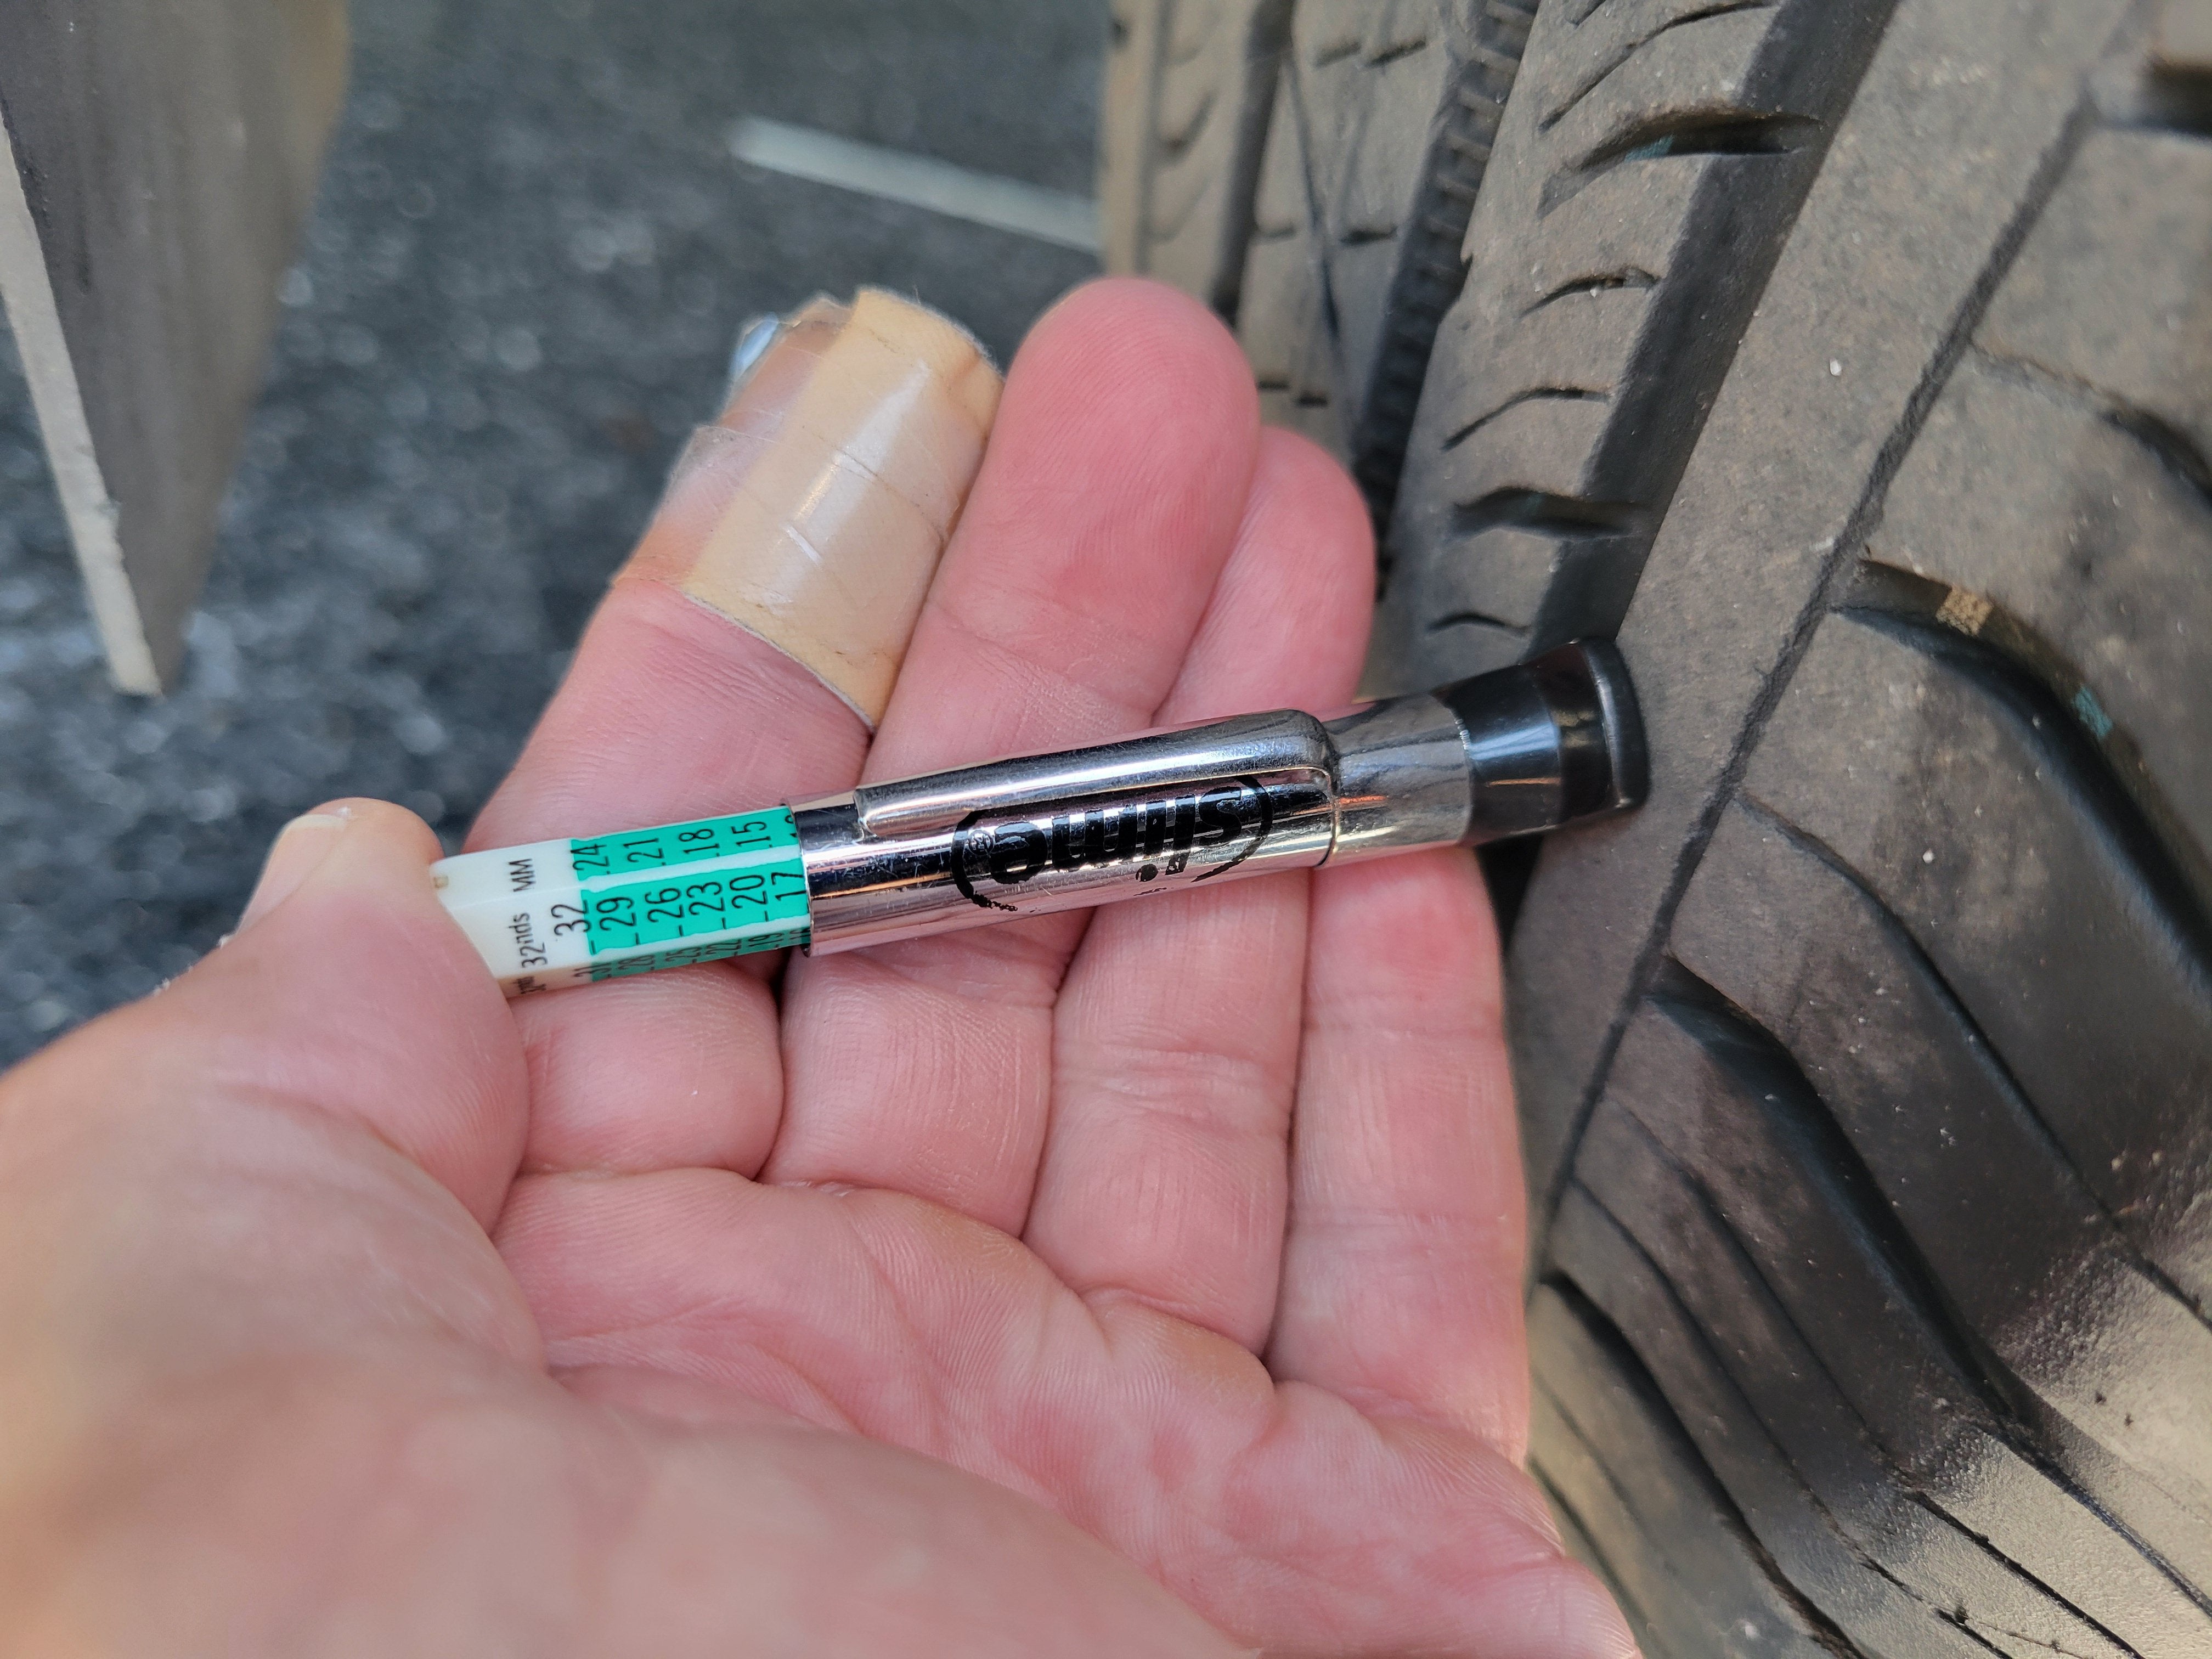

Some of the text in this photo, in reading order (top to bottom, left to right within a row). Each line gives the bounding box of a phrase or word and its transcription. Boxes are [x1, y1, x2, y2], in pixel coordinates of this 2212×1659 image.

[623, 838, 665, 862] 21
[679, 828, 720, 855] 18
[732, 821, 771, 848] 15
[571, 844, 610, 871] 24
[509, 859, 537, 892] MM
[730, 874, 768, 909] 20
[771, 872, 806, 901] 17
[596, 897, 637, 930] 29
[645, 888, 684, 923] 26
[686, 881, 726, 915] 23
[551, 900, 592, 936] 32
[509, 912, 548, 968] 32nds
